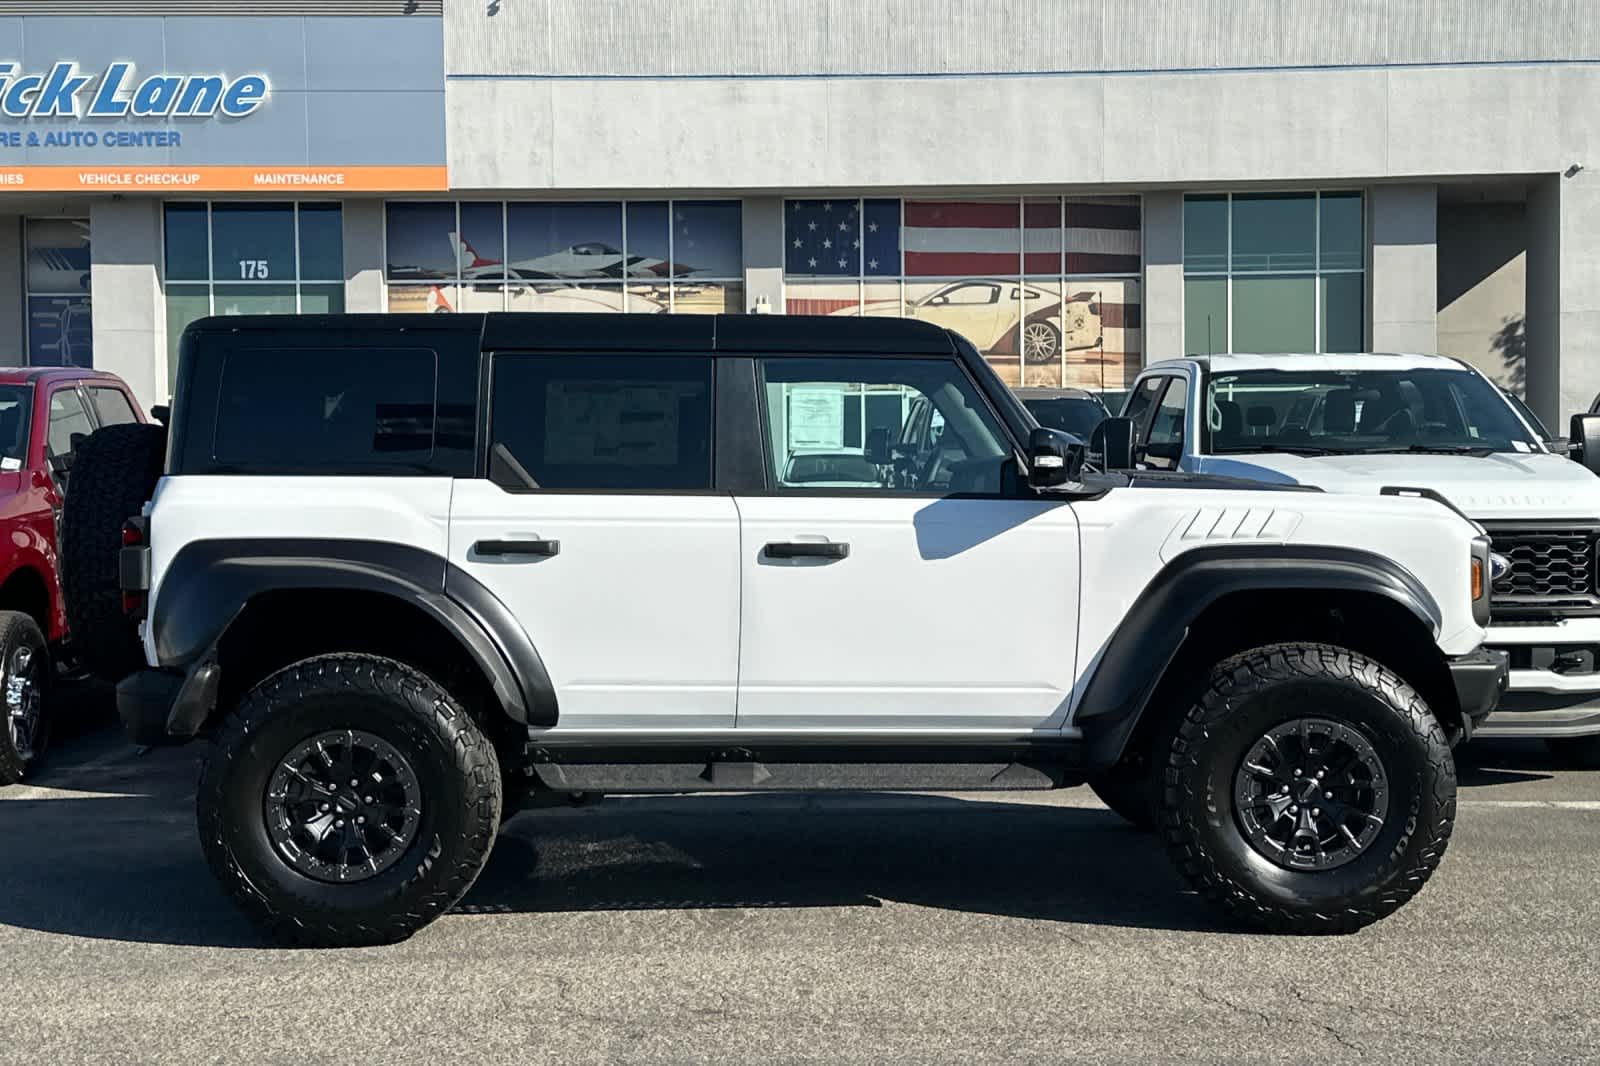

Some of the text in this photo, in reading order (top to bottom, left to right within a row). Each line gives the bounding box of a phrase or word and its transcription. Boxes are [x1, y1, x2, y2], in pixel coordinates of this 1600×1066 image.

[87, 62, 269, 117] Lane
[26, 131, 40, 147] &
[44, 131, 98, 147] AUTO
[103, 131, 181, 147] CENTER
[79, 173, 200, 185] VEHICLE CHECK-UP
[254, 173, 345, 185] MAINTENANCE
[239, 259, 269, 279] 175
